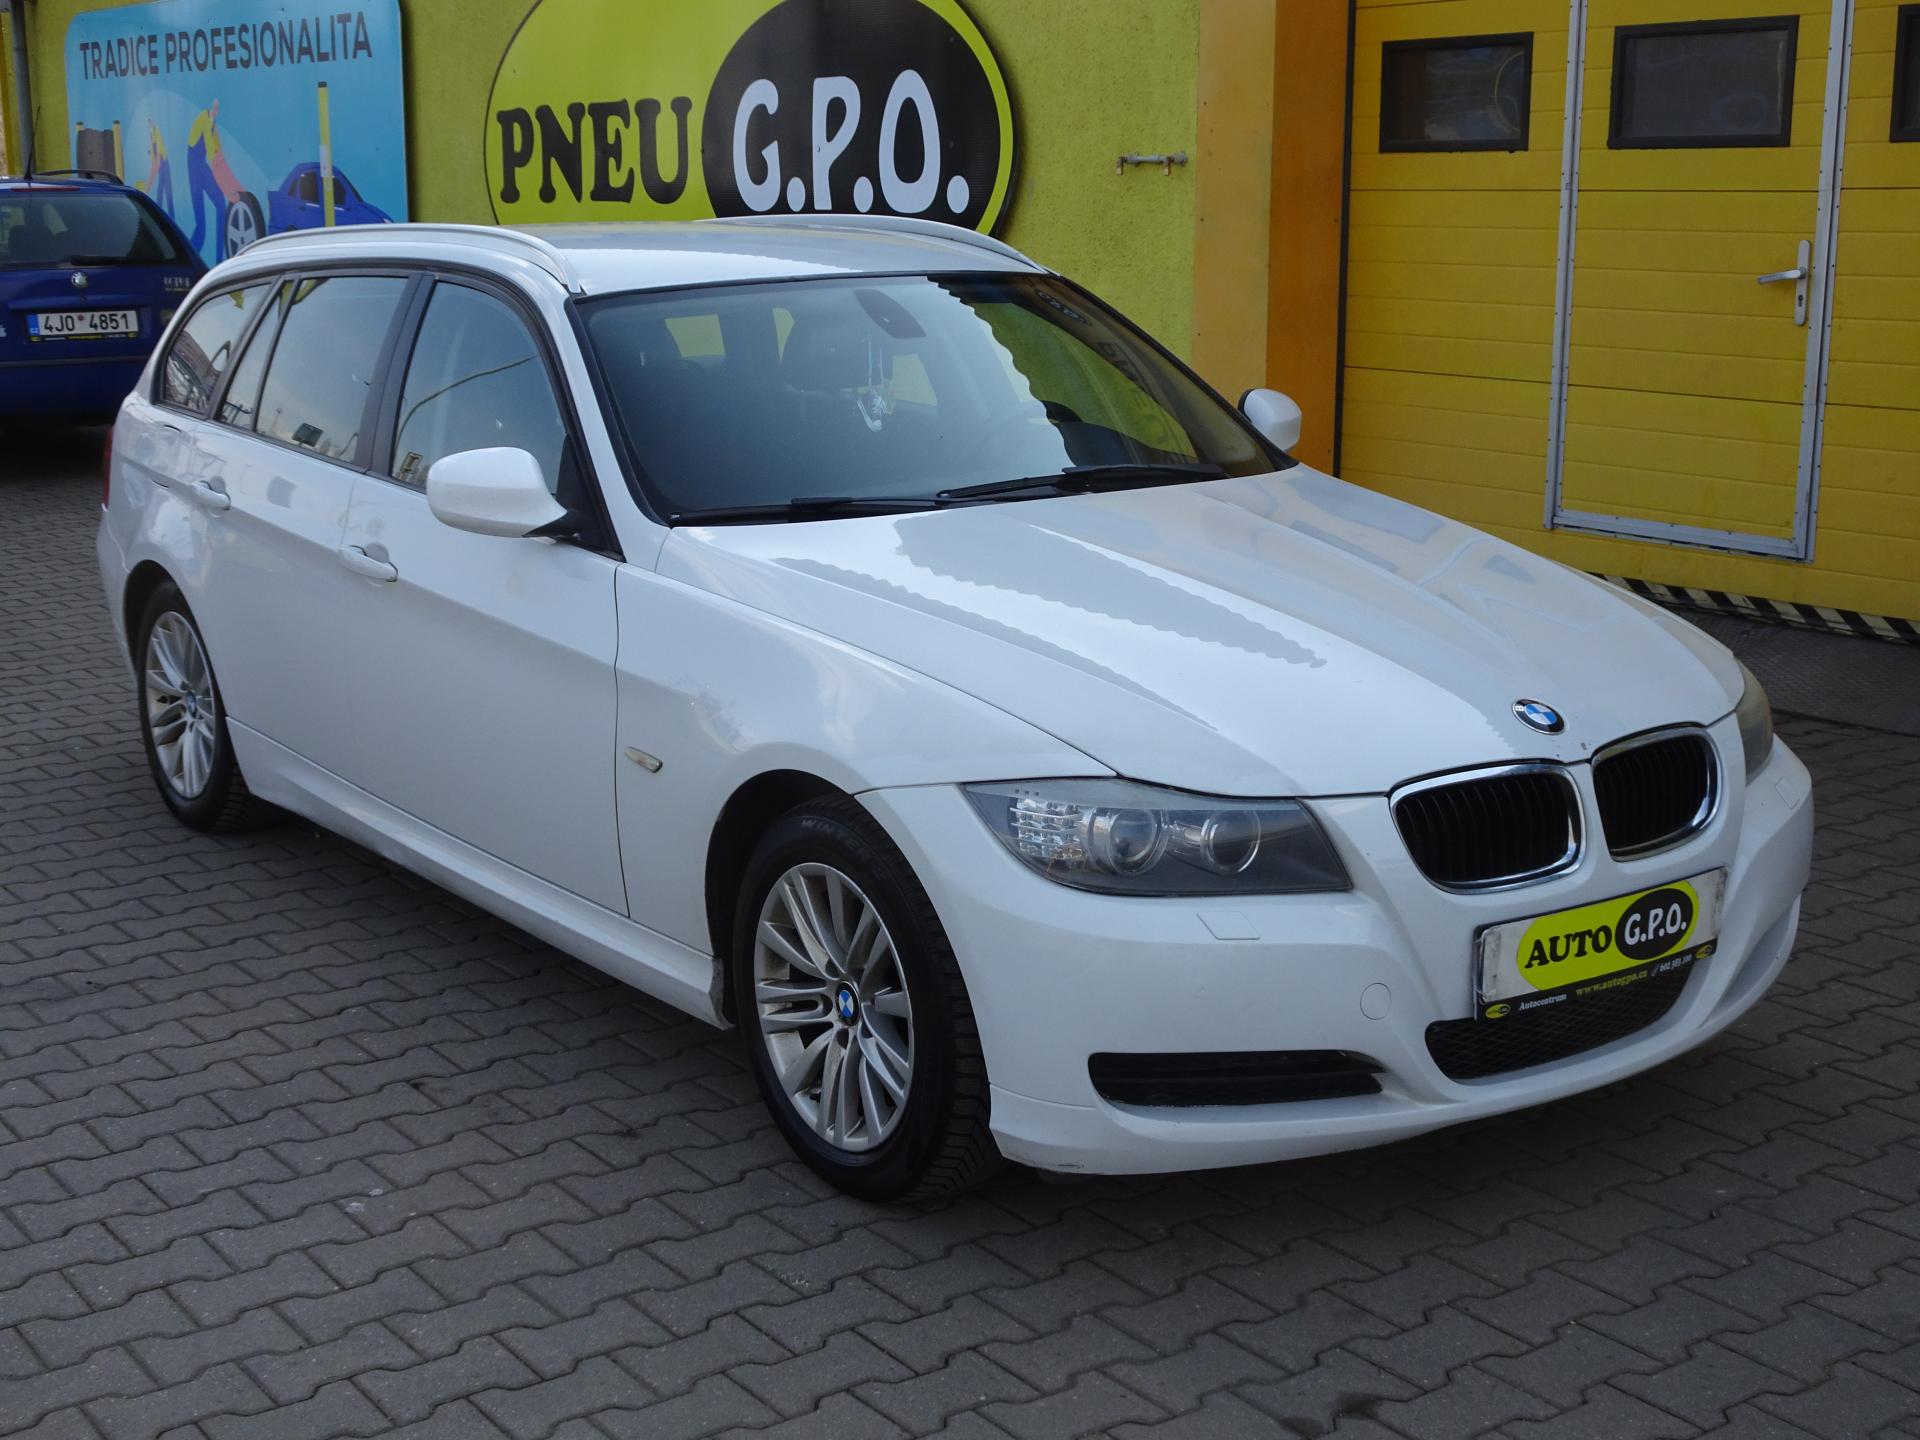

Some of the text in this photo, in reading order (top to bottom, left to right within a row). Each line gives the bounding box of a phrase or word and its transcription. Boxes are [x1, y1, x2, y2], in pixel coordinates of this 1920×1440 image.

[79, 11, 373, 80] TRADICE PROFESIONALITA
[496, 69, 970, 214] PNEU G.P.O.
[89, 312, 130, 331] 4851
[1524, 903, 1687, 969] AUTO G.P.O.
[1518, 992, 1568, 1011] Autocentrum
